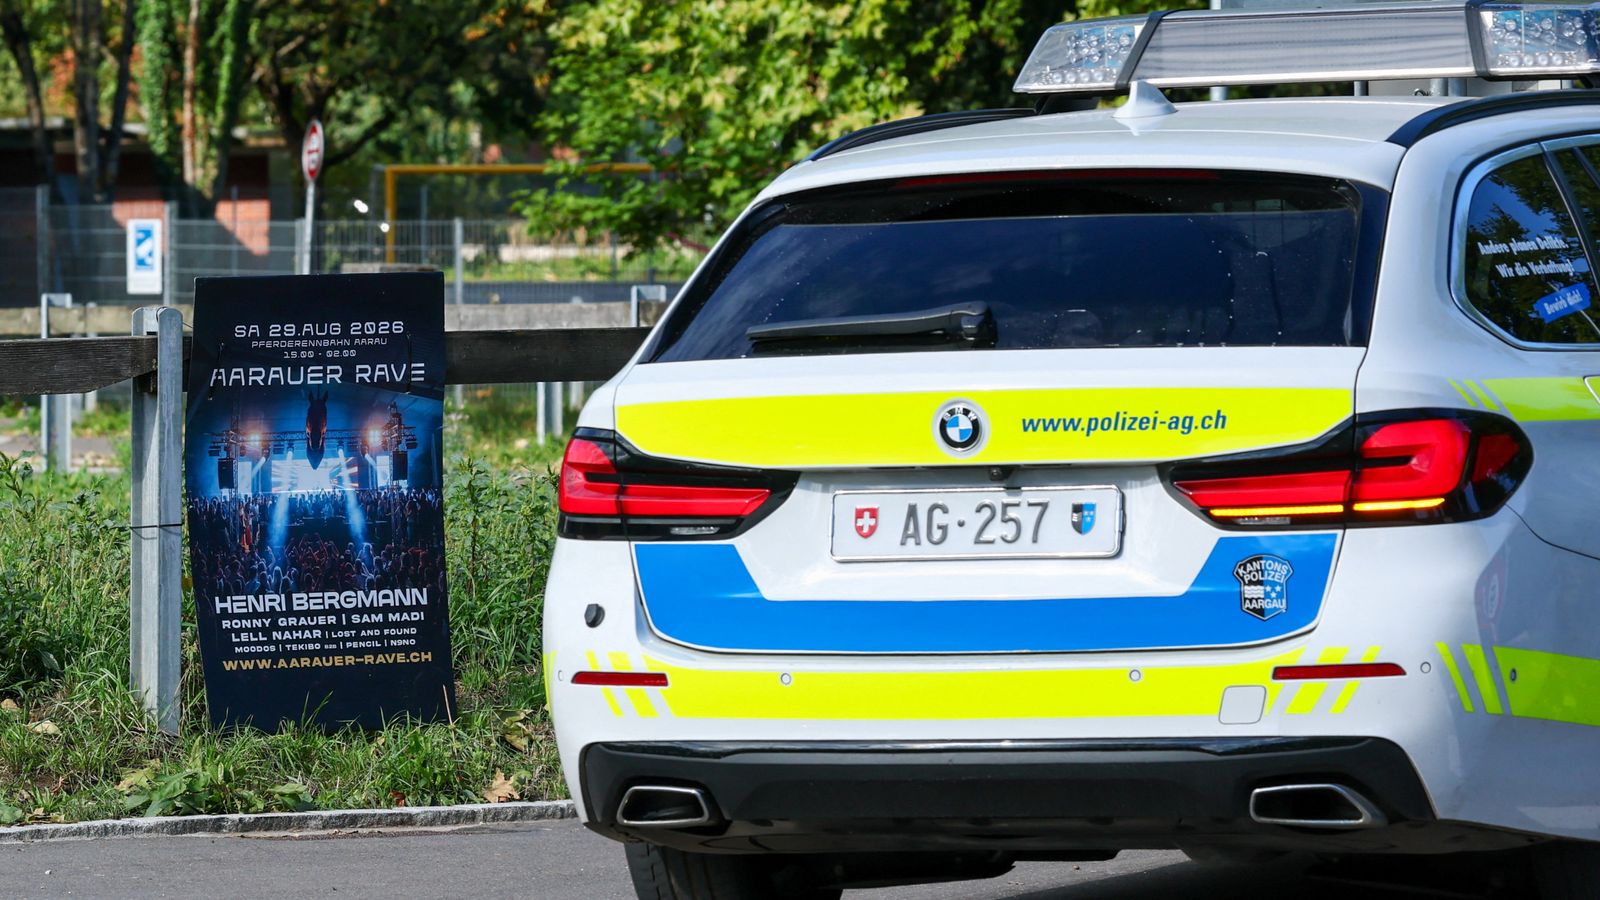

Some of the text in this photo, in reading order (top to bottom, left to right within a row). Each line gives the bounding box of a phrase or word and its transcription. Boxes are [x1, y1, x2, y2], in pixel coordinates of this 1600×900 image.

[1477, 240, 1510, 255] Andere
[1495, 263, 1515, 278] Wir
[1514, 262, 1530, 276] die
[234, 321, 404, 338] SA 29.AUG 2026
[251, 338, 388, 348] PFERDERENNBAHN AARAU
[283, 351, 315, 359] 15.00
[326, 350, 357, 358] 02.00
[209, 363, 425, 387] AARAUER RAVE
[943, 407, 978, 421] BMW
[1021, 410, 1228, 437] www.polizei-ag.ch
[1238, 560, 1288, 577] KANTONS
[1243, 570, 1285, 584] POLIZEI
[215, 588, 428, 614] HENRI BERGMANN
[1244, 599, 1286, 609] AARGAU
[222, 618, 272, 629] RONNY
[278, 616, 337, 626] GRAUER
[351, 613, 383, 623] SAM
[388, 611, 425, 622] MADI
[231, 632, 268, 642] LELL
[272, 629, 322, 641] NAHAR
[360, 629, 381, 637] AND
[384, 627, 417, 635] FOUND
[234, 645, 276, 653] MOODOS
[285, 643, 321, 651] TEKIBO
[346, 640, 382, 648] PENCIL
[223, 651, 433, 671] WWW.AARAUER-RAVE.CH
